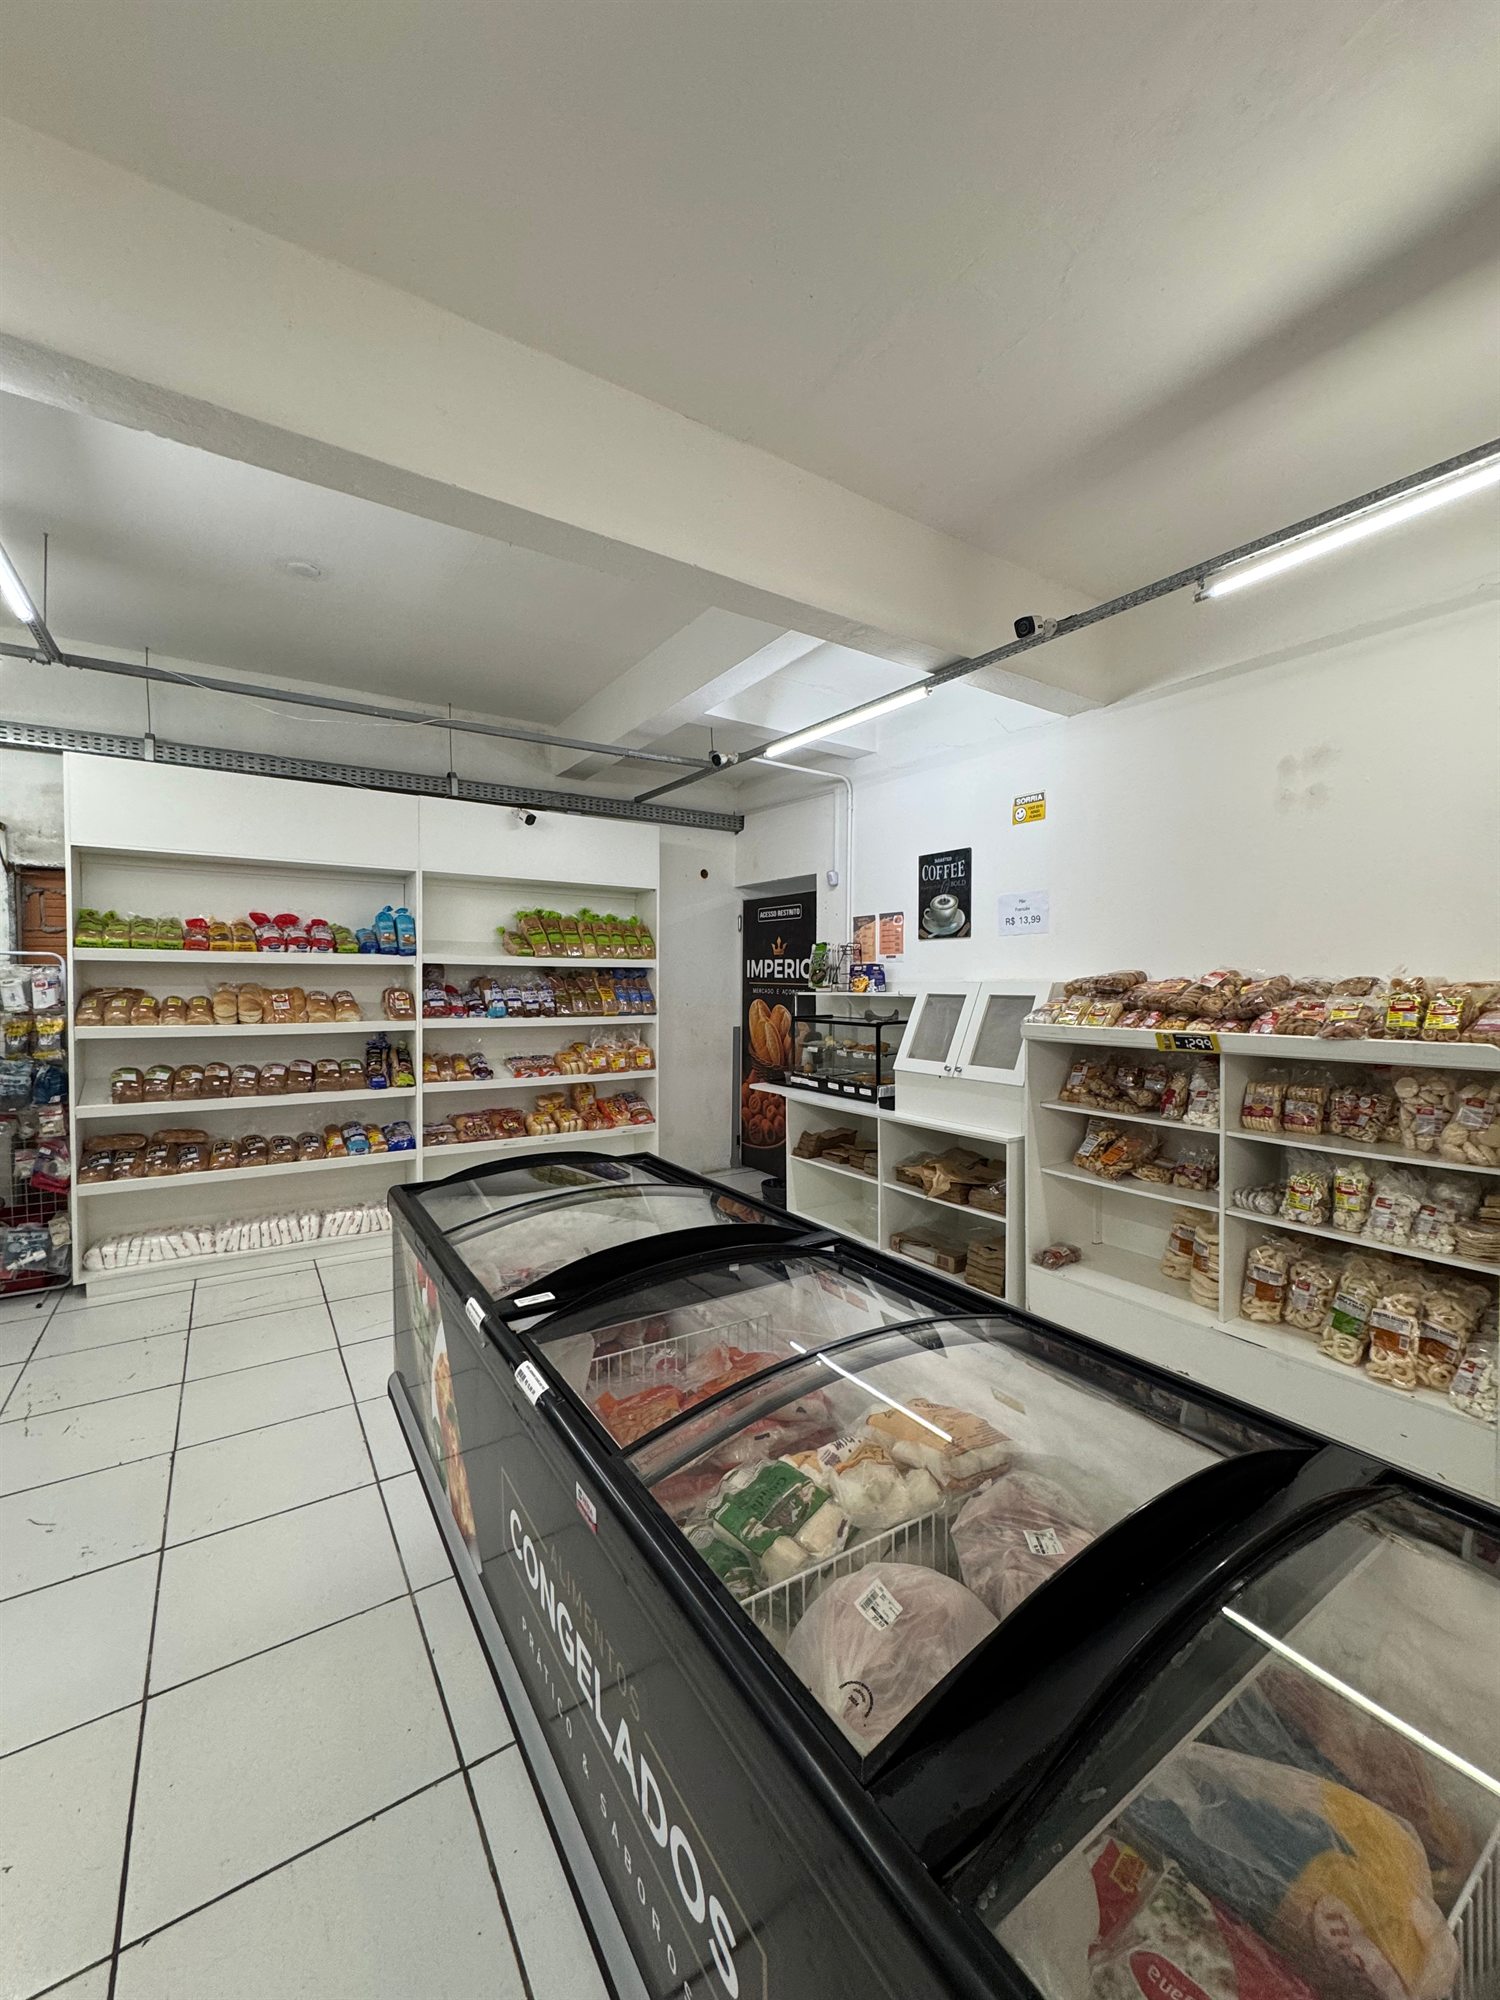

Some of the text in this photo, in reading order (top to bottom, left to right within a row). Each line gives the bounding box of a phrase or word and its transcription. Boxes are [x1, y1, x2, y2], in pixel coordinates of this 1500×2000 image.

[1016, 794, 1043, 806] SORRIA
[922, 860, 965, 881] COFFEE
[760, 908, 801, 919] ACESSO RESTRITO
[1005, 915, 1041, 926] R$ 13,99
[551, 1544, 640, 1722] ALIMENTOS
[521, 1615, 573, 1739] PRÁTICO
[583, 1753, 590, 1780] &
[509, 1508, 739, 2000] CONGELADOS
